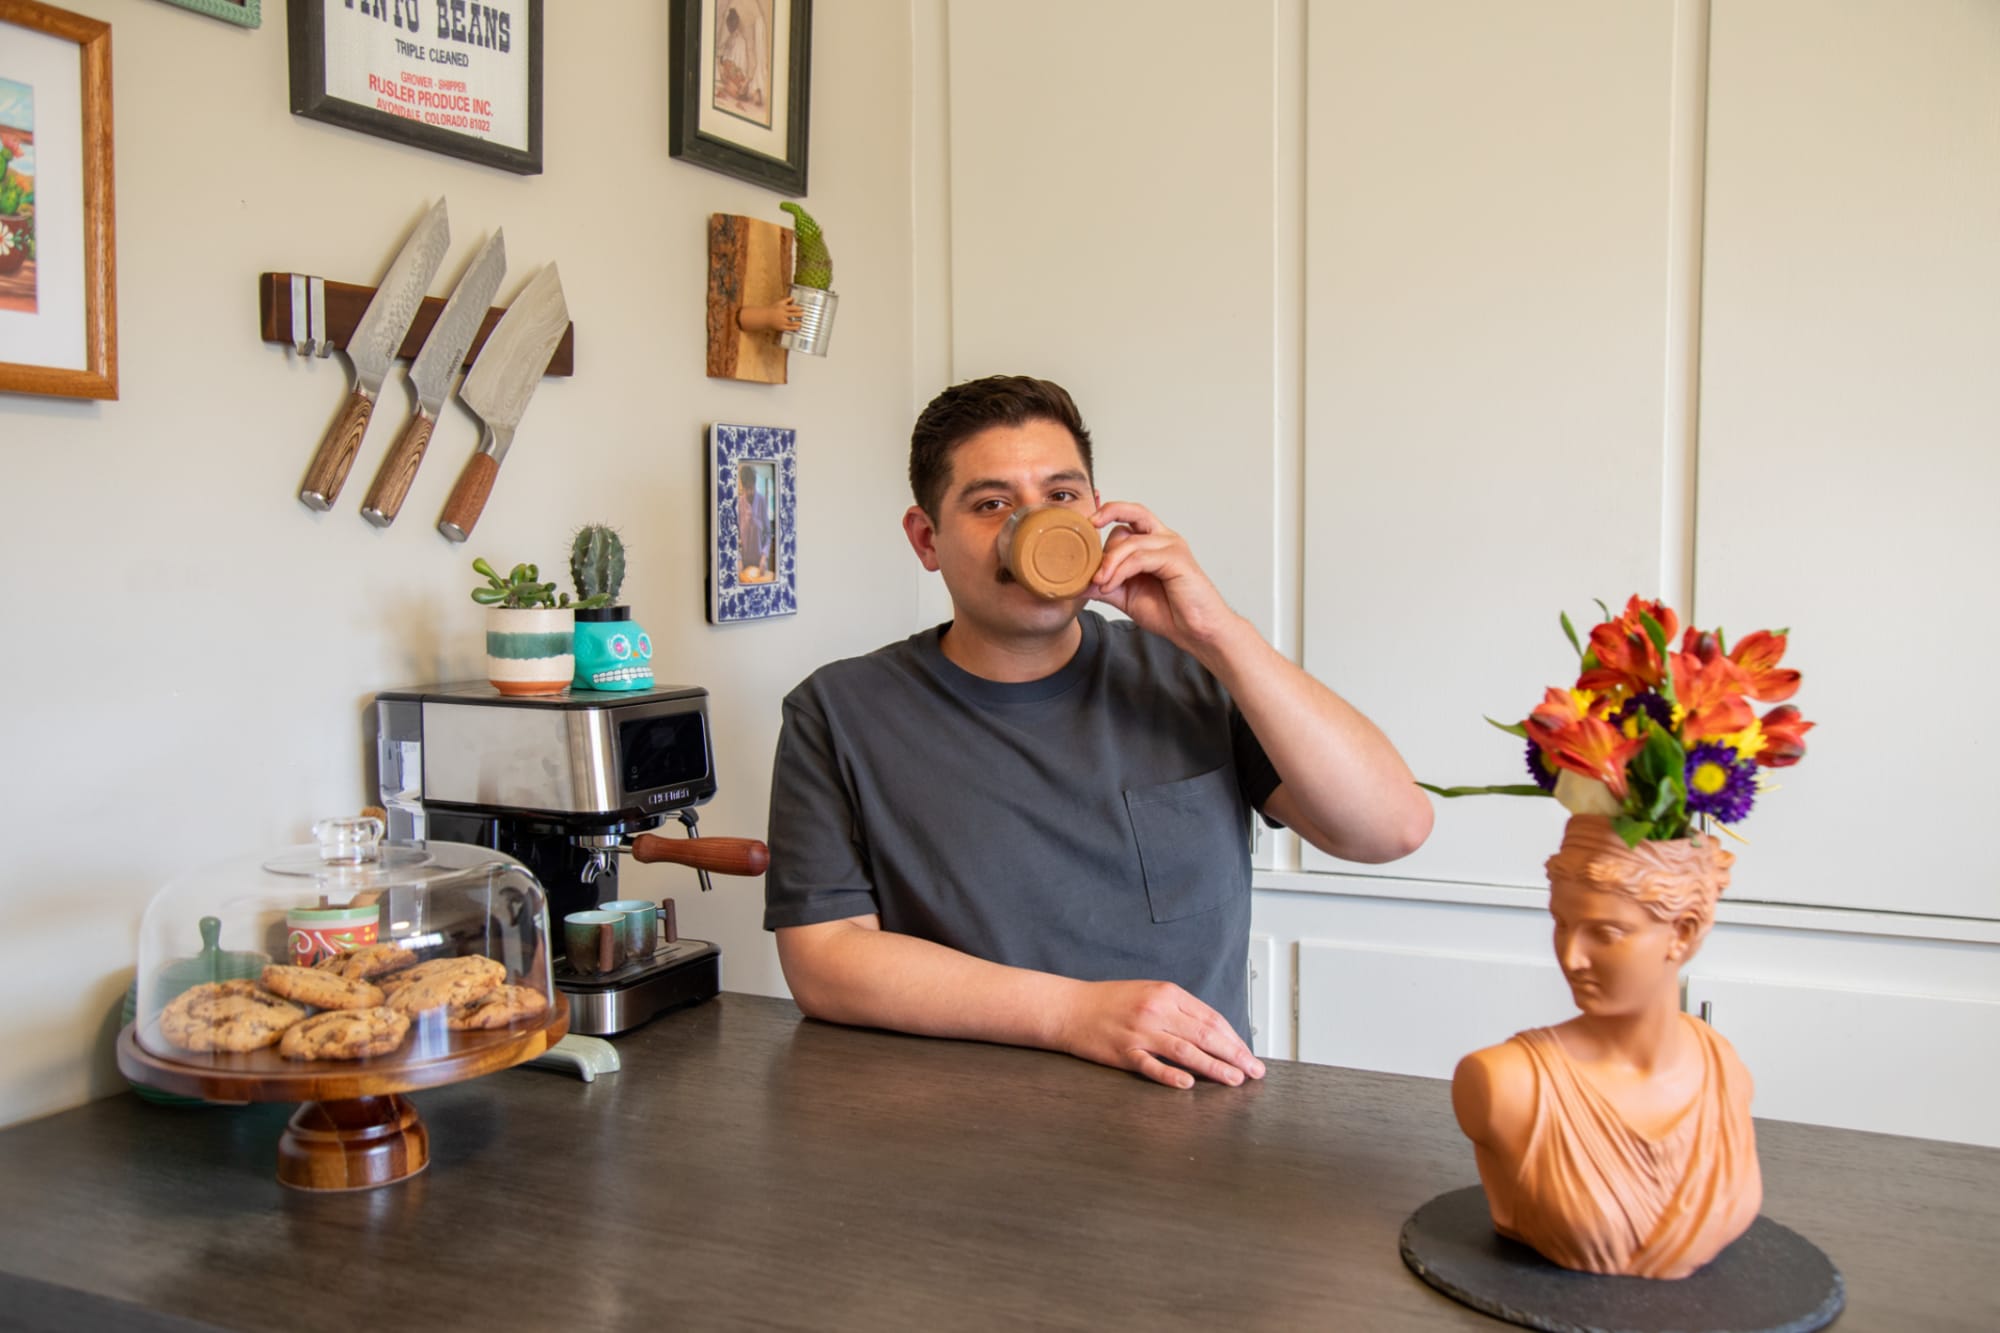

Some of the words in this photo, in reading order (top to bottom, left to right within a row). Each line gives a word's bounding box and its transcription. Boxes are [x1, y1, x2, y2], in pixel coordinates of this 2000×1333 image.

[345, 0, 419, 33] NTO
[436, 0, 510, 53] BEANS
[395, 38, 425, 60] TRIPLE
[429, 48, 469, 67] CLEANED
[369, 74, 415, 103] RUSLER
[418, 90, 470, 112] PRODUCE
[473, 99, 493, 116] INC.
[400, 71, 433, 88] GROWER
[438, 80, 466, 92] SHIPPER
[376, 98, 420, 122] AVONDALE
[425, 111, 468, 128] COLORADO
[469, 117, 490, 132] 81022
